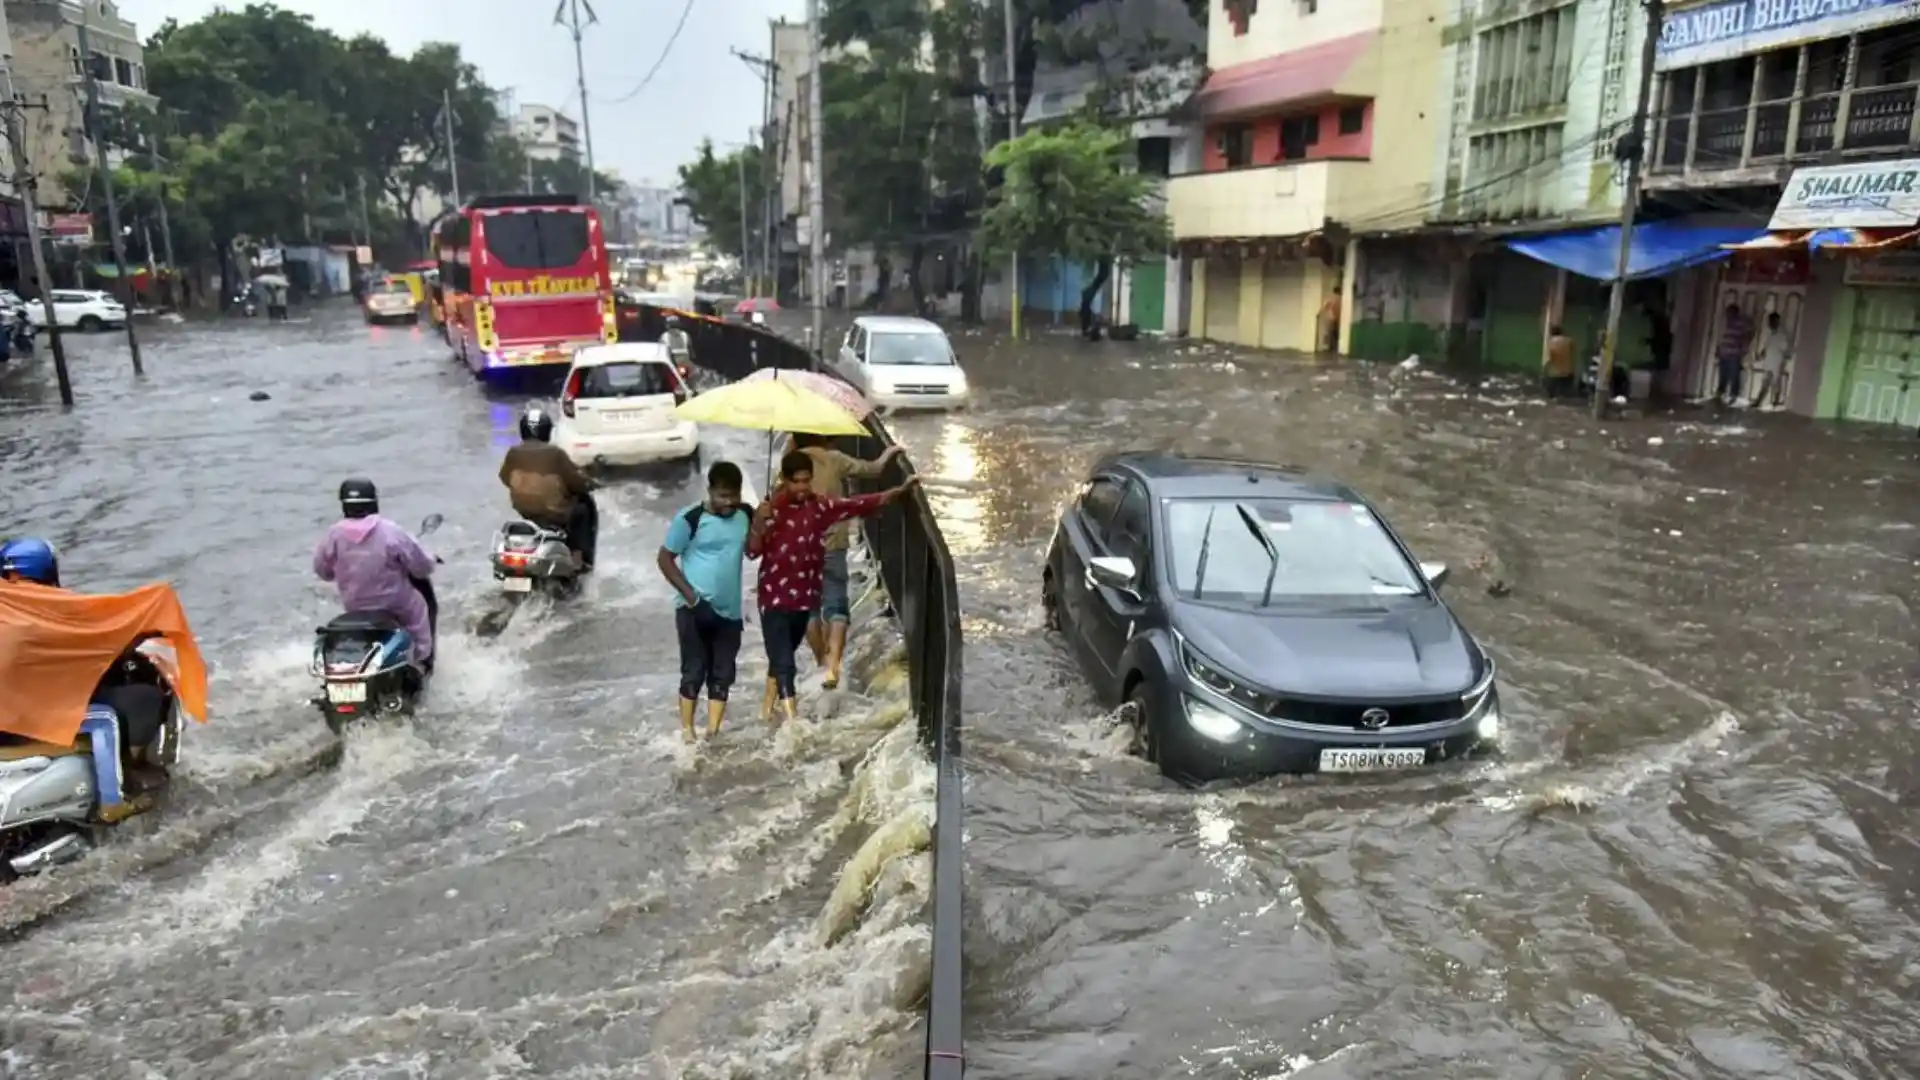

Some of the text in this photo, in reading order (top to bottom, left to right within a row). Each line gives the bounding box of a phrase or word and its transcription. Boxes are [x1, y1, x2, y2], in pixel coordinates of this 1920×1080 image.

[1663, 3, 1746, 47] GANDHI
[1752, 0, 1860, 29] BHAV
[1797, 171, 1918, 201] SHALIMAR
